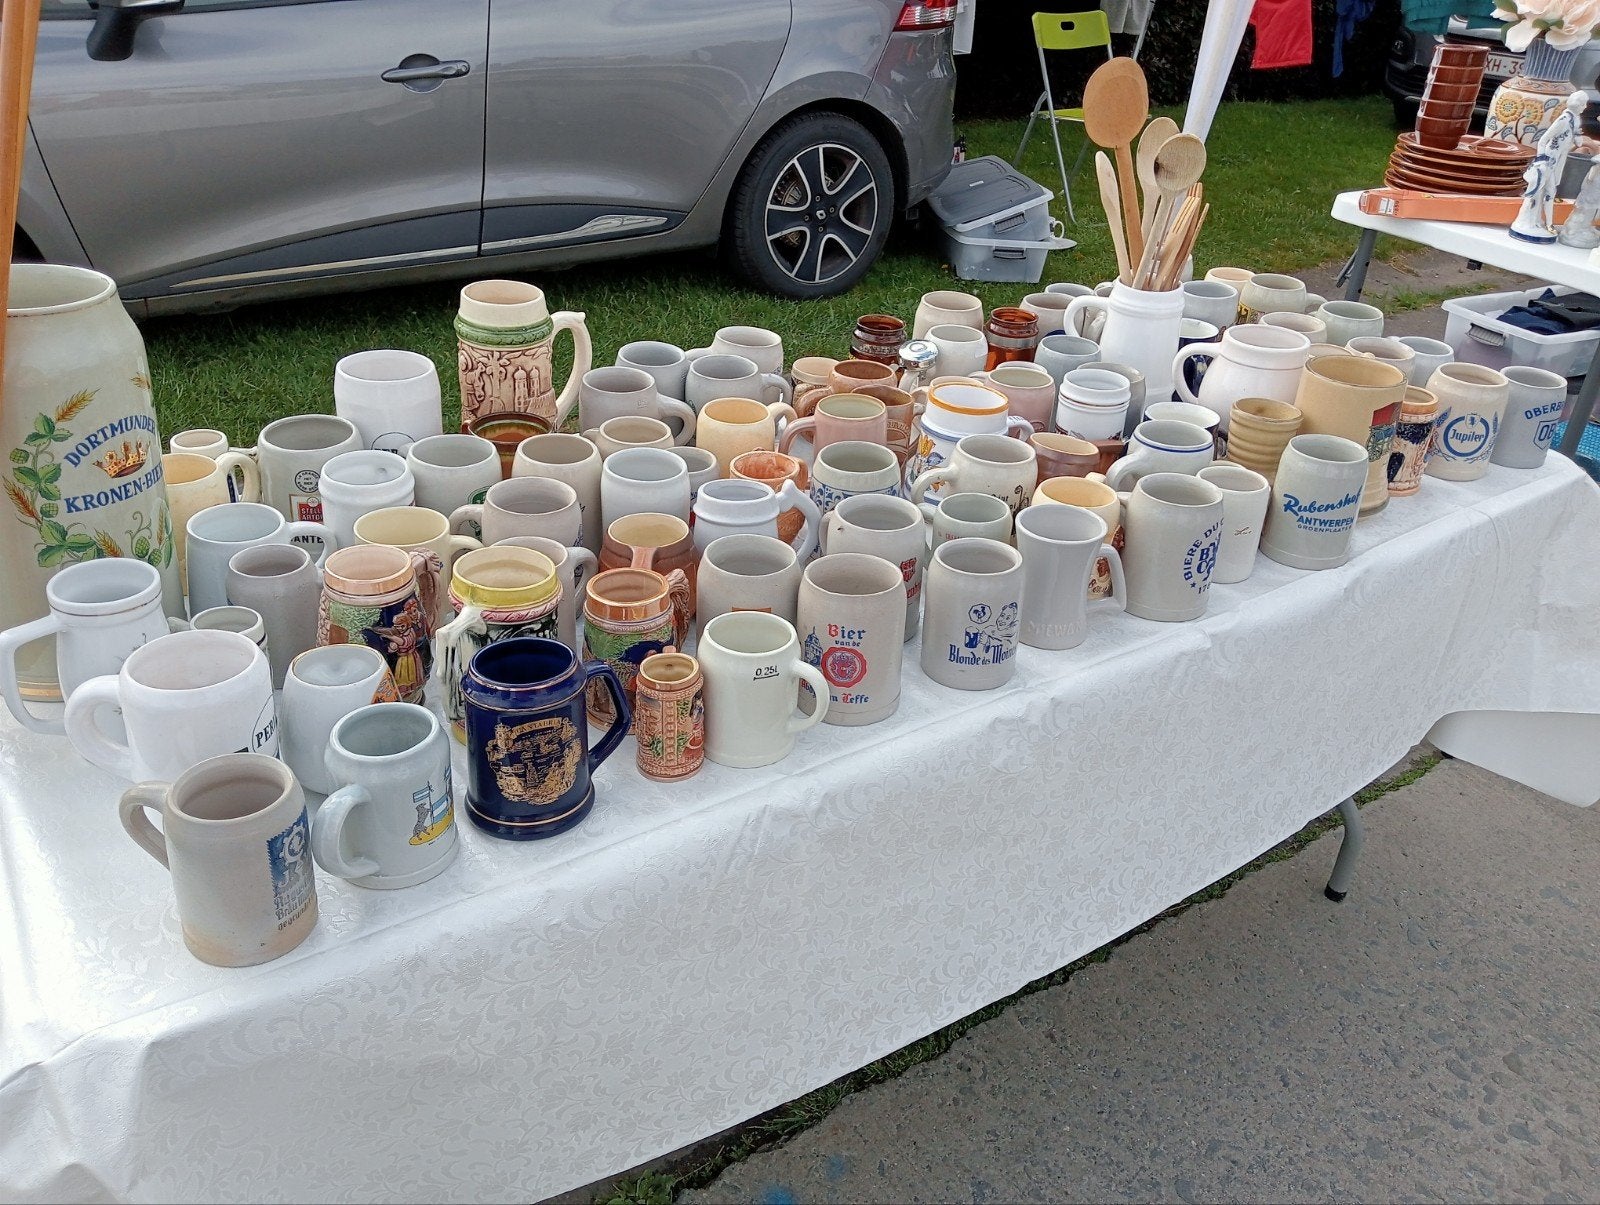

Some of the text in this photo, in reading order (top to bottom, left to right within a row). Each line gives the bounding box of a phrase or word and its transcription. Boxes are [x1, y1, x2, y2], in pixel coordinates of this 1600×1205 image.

[1450, 428, 1485, 444] Jupiler
[1296, 515, 1355, 528] ANTWERPEN
[1183, 539, 1203, 581] BIERE
[1203, 522, 1219, 539] DU
[827, 623, 867, 640] Bier
[948, 643, 981, 666] Blonde
[841, 692, 870, 704] Leffe
